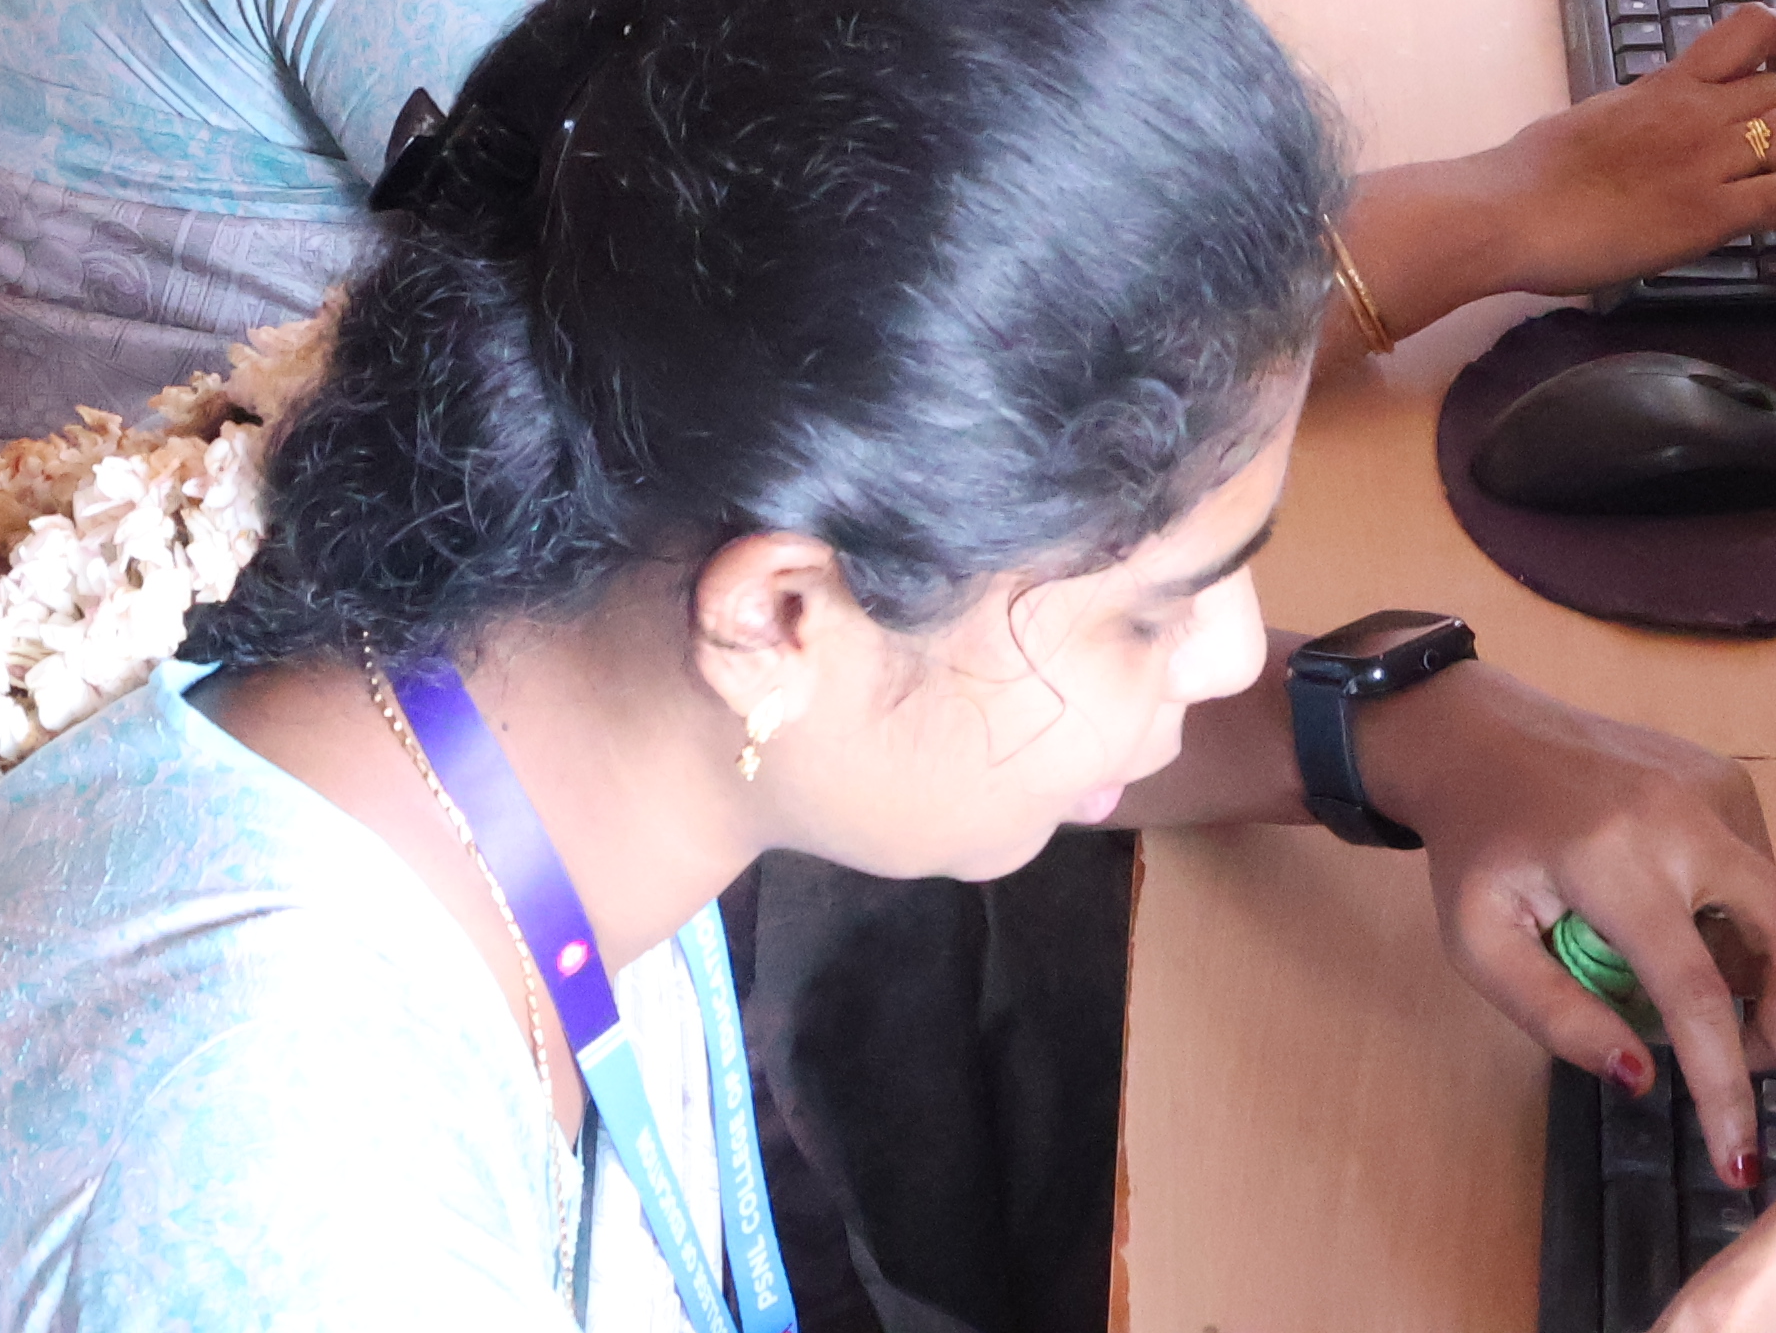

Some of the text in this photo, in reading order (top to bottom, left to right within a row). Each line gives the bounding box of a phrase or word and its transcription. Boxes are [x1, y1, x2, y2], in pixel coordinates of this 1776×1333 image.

[724, 1070, 743, 1110] OF
[729, 1108, 761, 1235] COLLEGE
[693, 1261, 728, 1333] OLLEGE
[747, 1234, 779, 1312] PSNL
